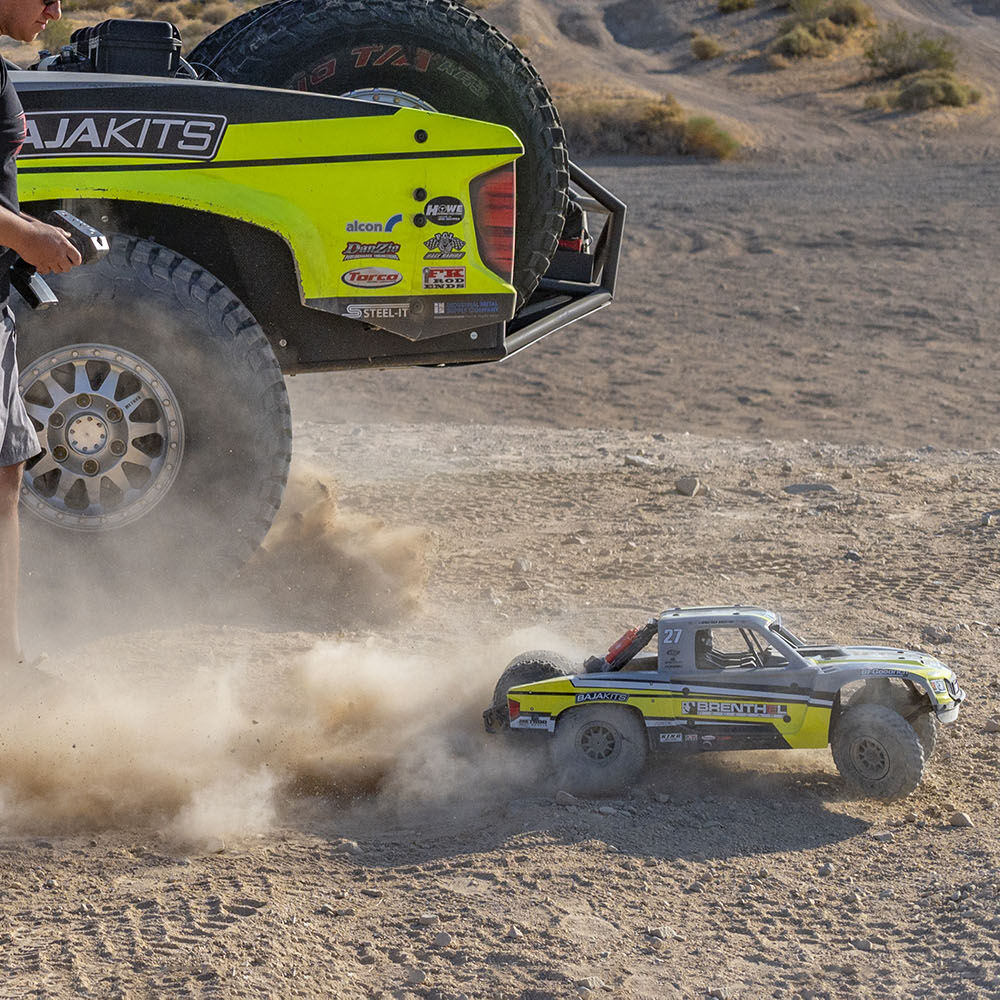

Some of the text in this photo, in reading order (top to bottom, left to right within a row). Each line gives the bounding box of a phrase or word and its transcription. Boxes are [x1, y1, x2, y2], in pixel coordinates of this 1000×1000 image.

[25, 117, 216, 151] AJAKITS
[346, 220, 383, 232] alcon
[428, 268, 464, 278] FK
[364, 308, 408, 318] STEEL-IT
[663, 629, 682, 644] 27
[577, 693, 627, 702] BAJAKITS
[697, 702, 787, 714] BRENTHEL
